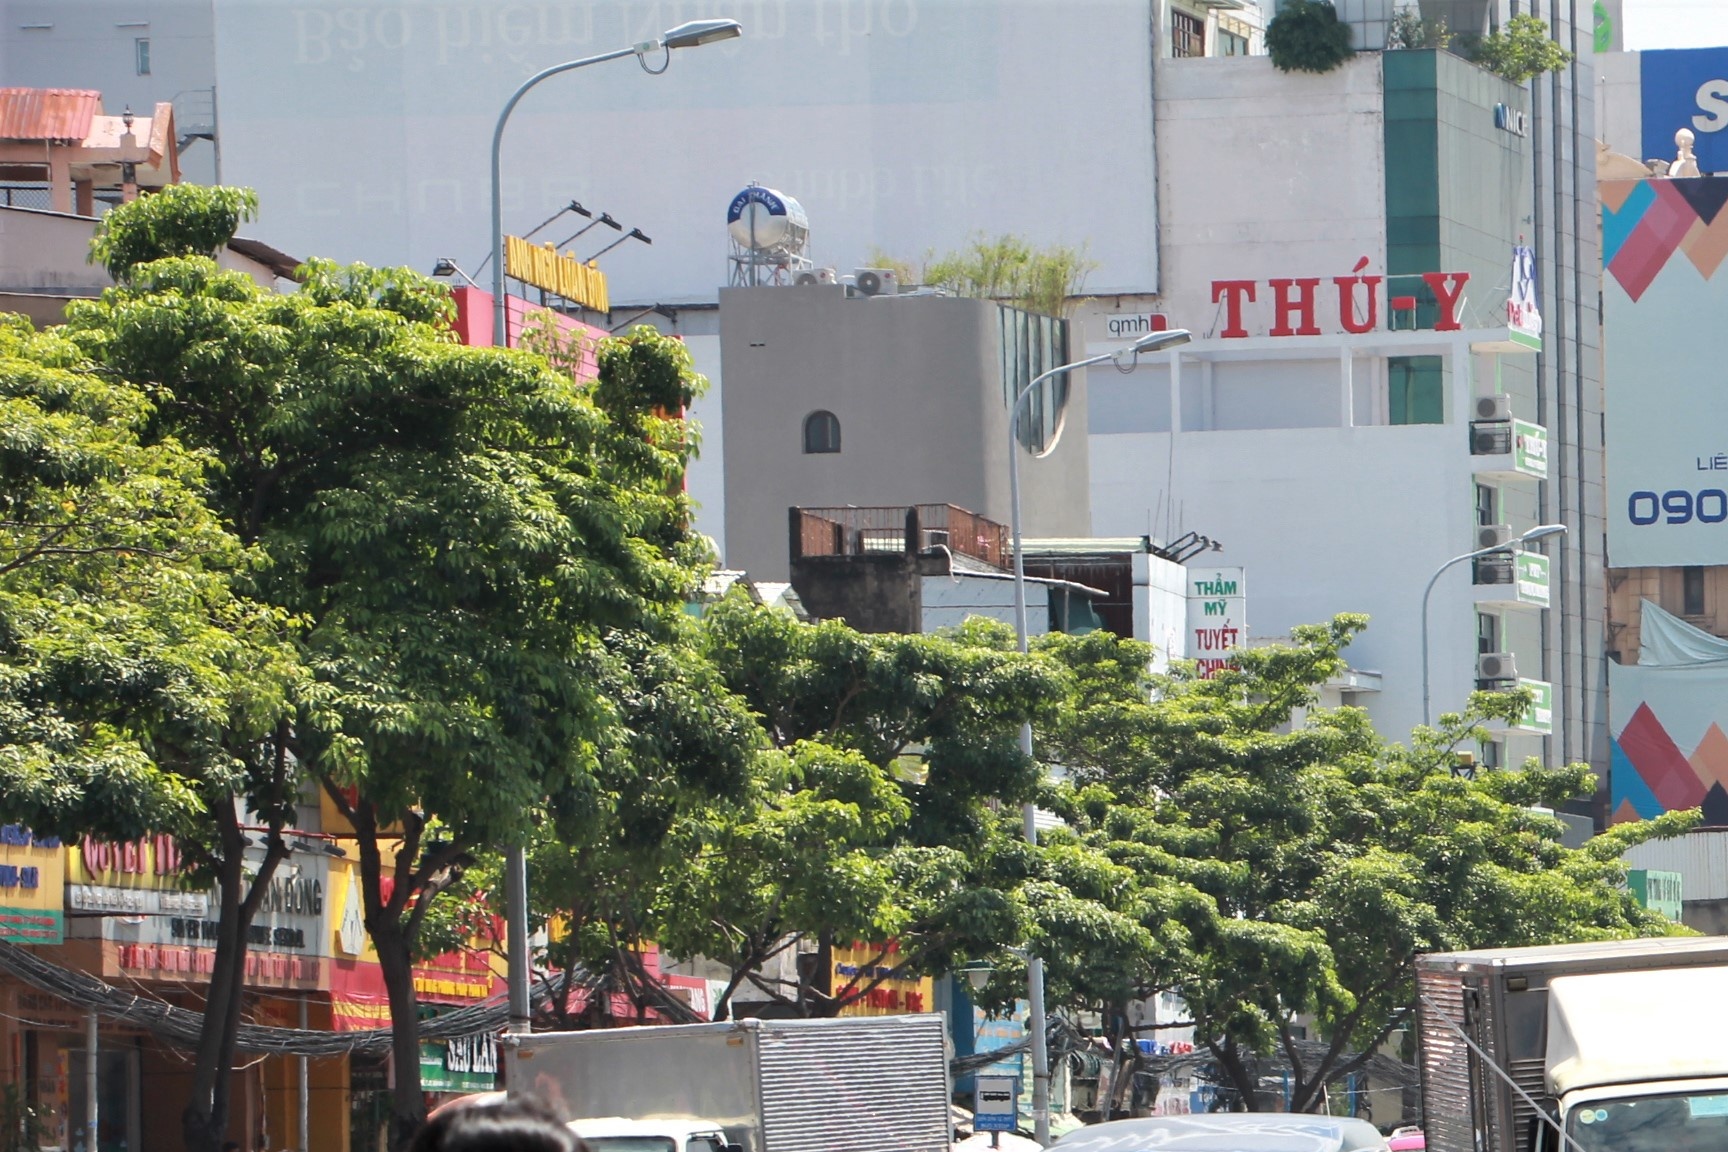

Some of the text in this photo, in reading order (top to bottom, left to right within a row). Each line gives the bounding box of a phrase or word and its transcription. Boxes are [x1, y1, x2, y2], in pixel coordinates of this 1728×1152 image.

[1211, 256, 1470, 338] THÚ-Y
[1108, 314, 1150, 337] qmh
[1194, 572, 1237, 595] THẨM
[1204, 598, 1228, 616] MỸ
[1195, 618, 1238, 651] TUYẾT
